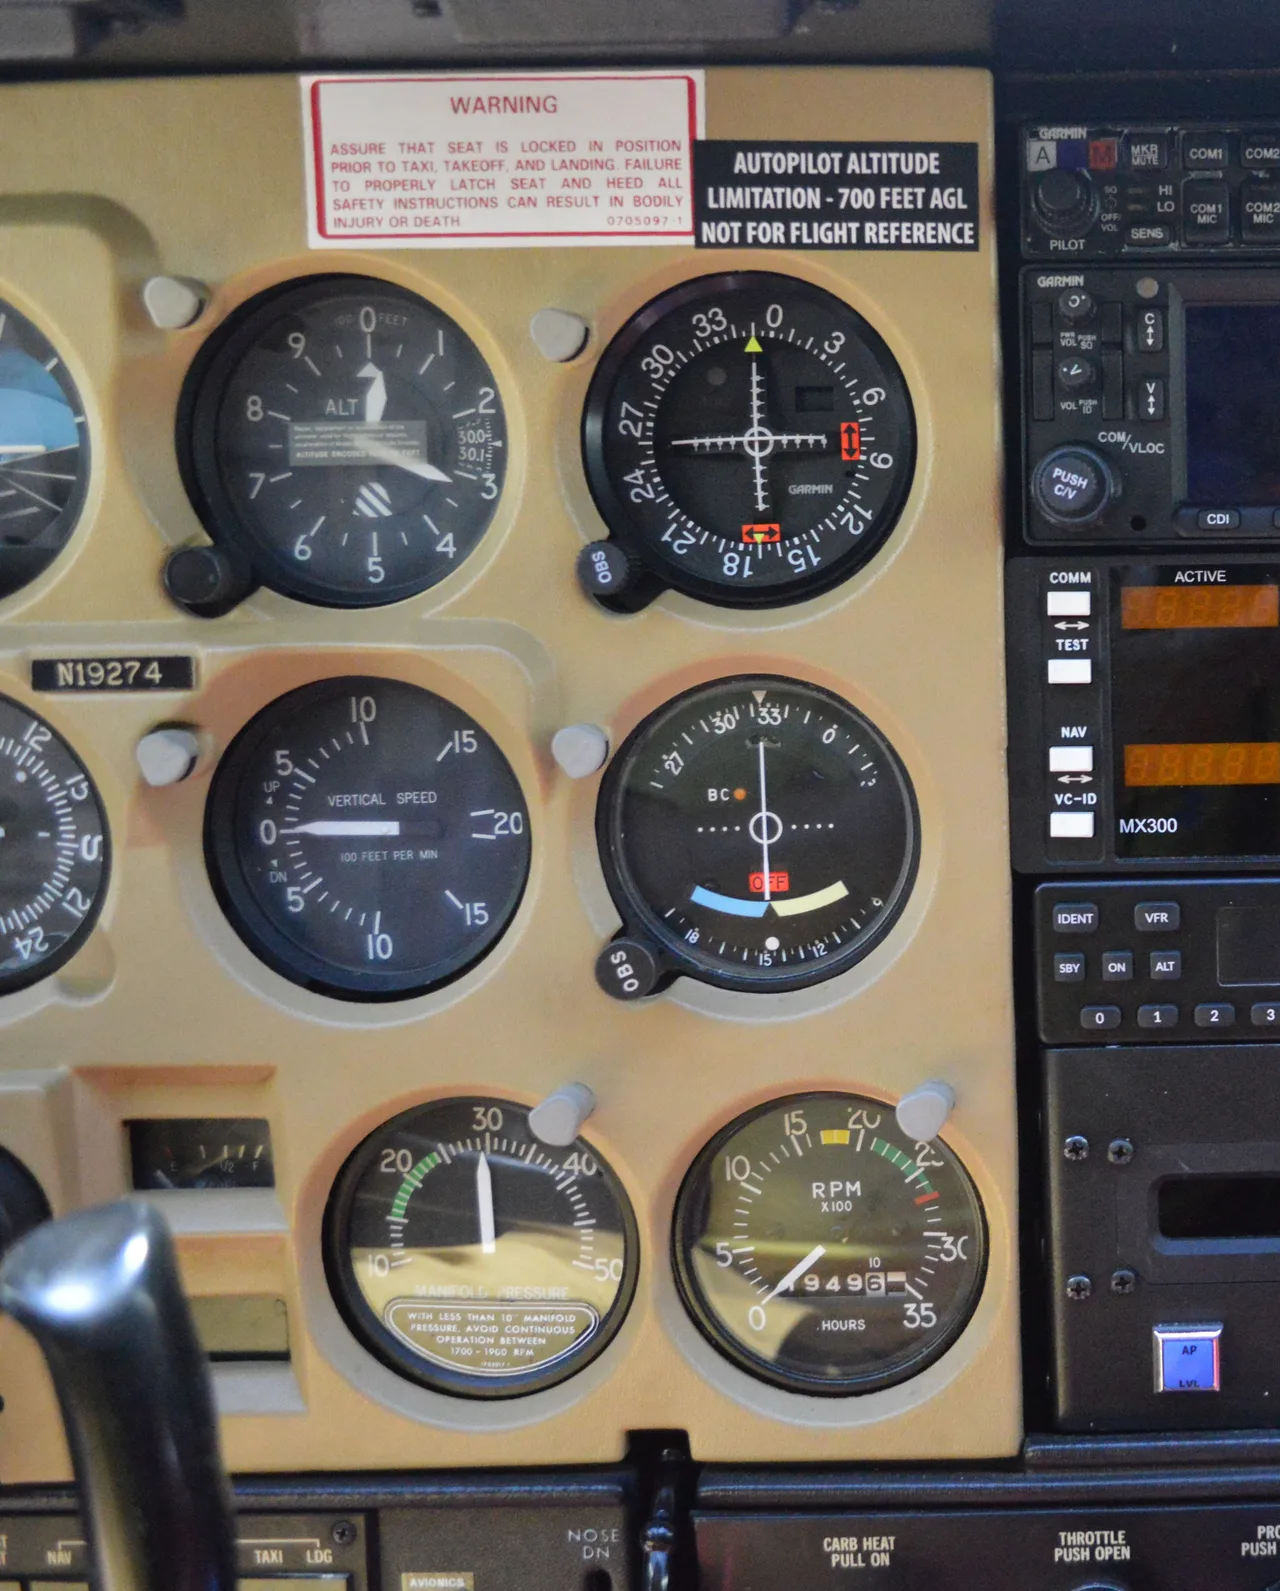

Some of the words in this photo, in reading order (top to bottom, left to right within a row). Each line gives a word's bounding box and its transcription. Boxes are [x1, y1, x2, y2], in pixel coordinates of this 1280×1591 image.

[450, 96, 558, 115] WARNING
[331, 143, 386, 155] ASSURE
[399, 142, 435, 153] THAT
[448, 142, 483, 153] SEAT
[521, 141, 576, 152] LOCKED
[616, 140, 681, 151] POSITION
[1246, 148, 1280, 159] COM2
[332, 162, 371, 173] PRIOR
[378, 161, 395, 172] TO
[516, 160, 545, 171] AND
[625, 159, 682, 170] FAILURE
[734, 152, 842, 174] AUTOPILOT
[847, 152, 940, 174] ALTITUDE
[365, 180, 435, 191] PROPERLY
[451, 179, 495, 190] LATCH
[511, 178, 546, 189] SEAT
[561, 178, 591, 189] AND
[607, 178, 642, 188] HEED
[658, 177, 682, 188] ALL
[333, 199, 384, 210] SAFETY
[394, 197, 498, 210] INSTRUCTIONS
[508, 197, 537, 208] CAN
[547, 196, 599, 207] RESULT
[634, 196, 682, 207] BODILY
[708, 188, 820, 209] LIMITATION
[839, 188, 874, 208] 700
[881, 188, 925, 208] FEET
[930, 188, 967, 209] AGL
[334, 217, 384, 228] INJURY
[390, 216, 408, 227] OR
[414, 216, 460, 227] DEATH
[702, 222, 741, 243] NOT
[747, 222, 785, 243] FOR
[791, 222, 859, 244] FLIGHT
[865, 223, 974, 244] REFERENCE
[1131, 228, 1163, 239] SENS
[1037, 276, 1084, 287] GARMIN
[325, 399, 358, 415] ALT
[788, 485, 833, 495] GARMIN
[1207, 513, 1229, 525] CDI
[1049, 572, 1091, 584] COMM
[1174, 571, 1226, 583] ACTIVE
[1056, 639, 1089, 651] TEST
[56, 662, 163, 687] N19274
[1061, 726, 1087, 738] NAV
[328, 793, 386, 807] VERTICAL
[397, 792, 437, 805] SPEED
[1054, 793, 1097, 805] VC-ID
[494, 812, 523, 835] 20
[1119, 818, 1178, 834] MX300
[1057, 913, 1094, 924] IDENT
[1144, 913, 1169, 923] VFR
[367, 934, 393, 959] 10
[1059, 963, 1080, 974] SBY
[1108, 962, 1126, 973] ON
[1155, 961, 1175, 971] ALT
[472, 1107, 503, 1131] 30
[380, 1149, 413, 1173] 20
[812, 1180, 861, 1198] RPM
[821, 1201, 852, 1212] X100
[468, 1313, 494, 1321] THAN
[524, 1314, 576, 1322] MANIFOLD
[903, 1303, 937, 1328] 35
[505, 1325, 575, 1334] CONTINUOUS
[821, 1319, 866, 1330] HOURS
[436, 1336, 494, 1344] OPERATION
[568, 1529, 621, 1543] NOSE
[1059, 1531, 1126, 1546] THROTTLE
[823, 1537, 859, 1552] CARB
[862, 1536, 895, 1551] HEAT
[1241, 1541, 1277, 1557] PUSH
[254, 1549, 283, 1564] TAXI
[306, 1549, 332, 1564] LDG
[831, 1553, 866, 1568] PULL
[871, 1552, 890, 1566] ON
[1054, 1547, 1091, 1563] PUSH
[1095, 1546, 1131, 1561] OPEN
